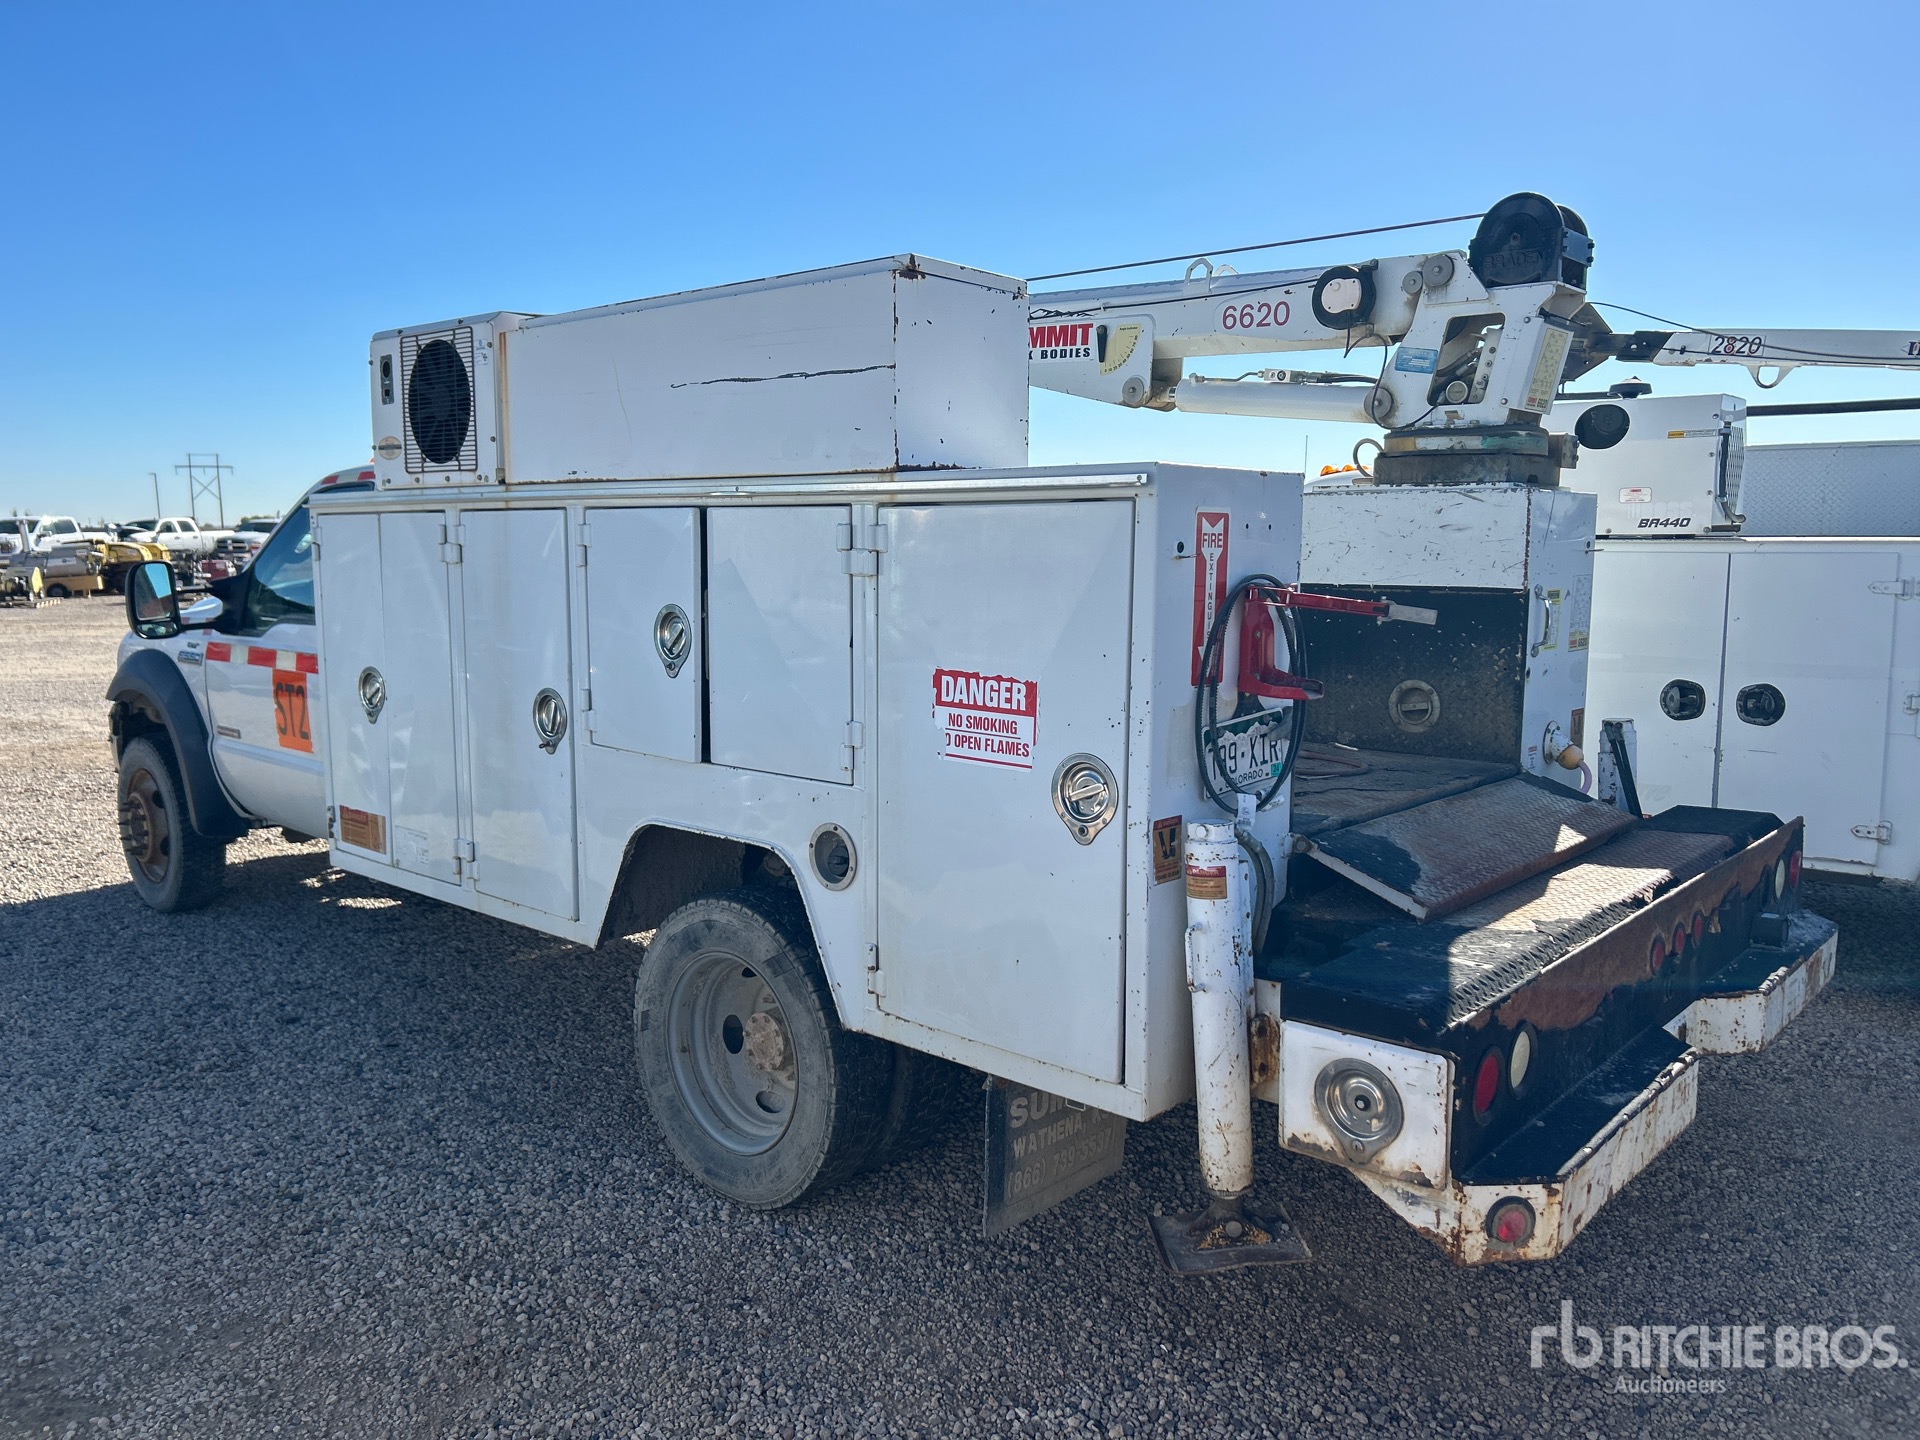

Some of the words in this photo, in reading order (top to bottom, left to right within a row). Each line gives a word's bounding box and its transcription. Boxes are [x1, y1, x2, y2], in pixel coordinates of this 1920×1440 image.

[1484, 249, 1545, 269] BRADEN
[1222, 301, 1290, 330] 6620
[1041, 347, 1091, 360] BODIES
[1711, 336, 1762, 354] 2820
[1202, 532, 1223, 549] FIRE
[941, 675, 1026, 711] DANGER
[948, 713, 963, 728] NO
[966, 715, 1018, 735] SMOKING
[954, 733, 981, 751] OPEN
[984, 738, 1030, 758] FLAMES
[1225, 768, 1264, 788] LORADO
